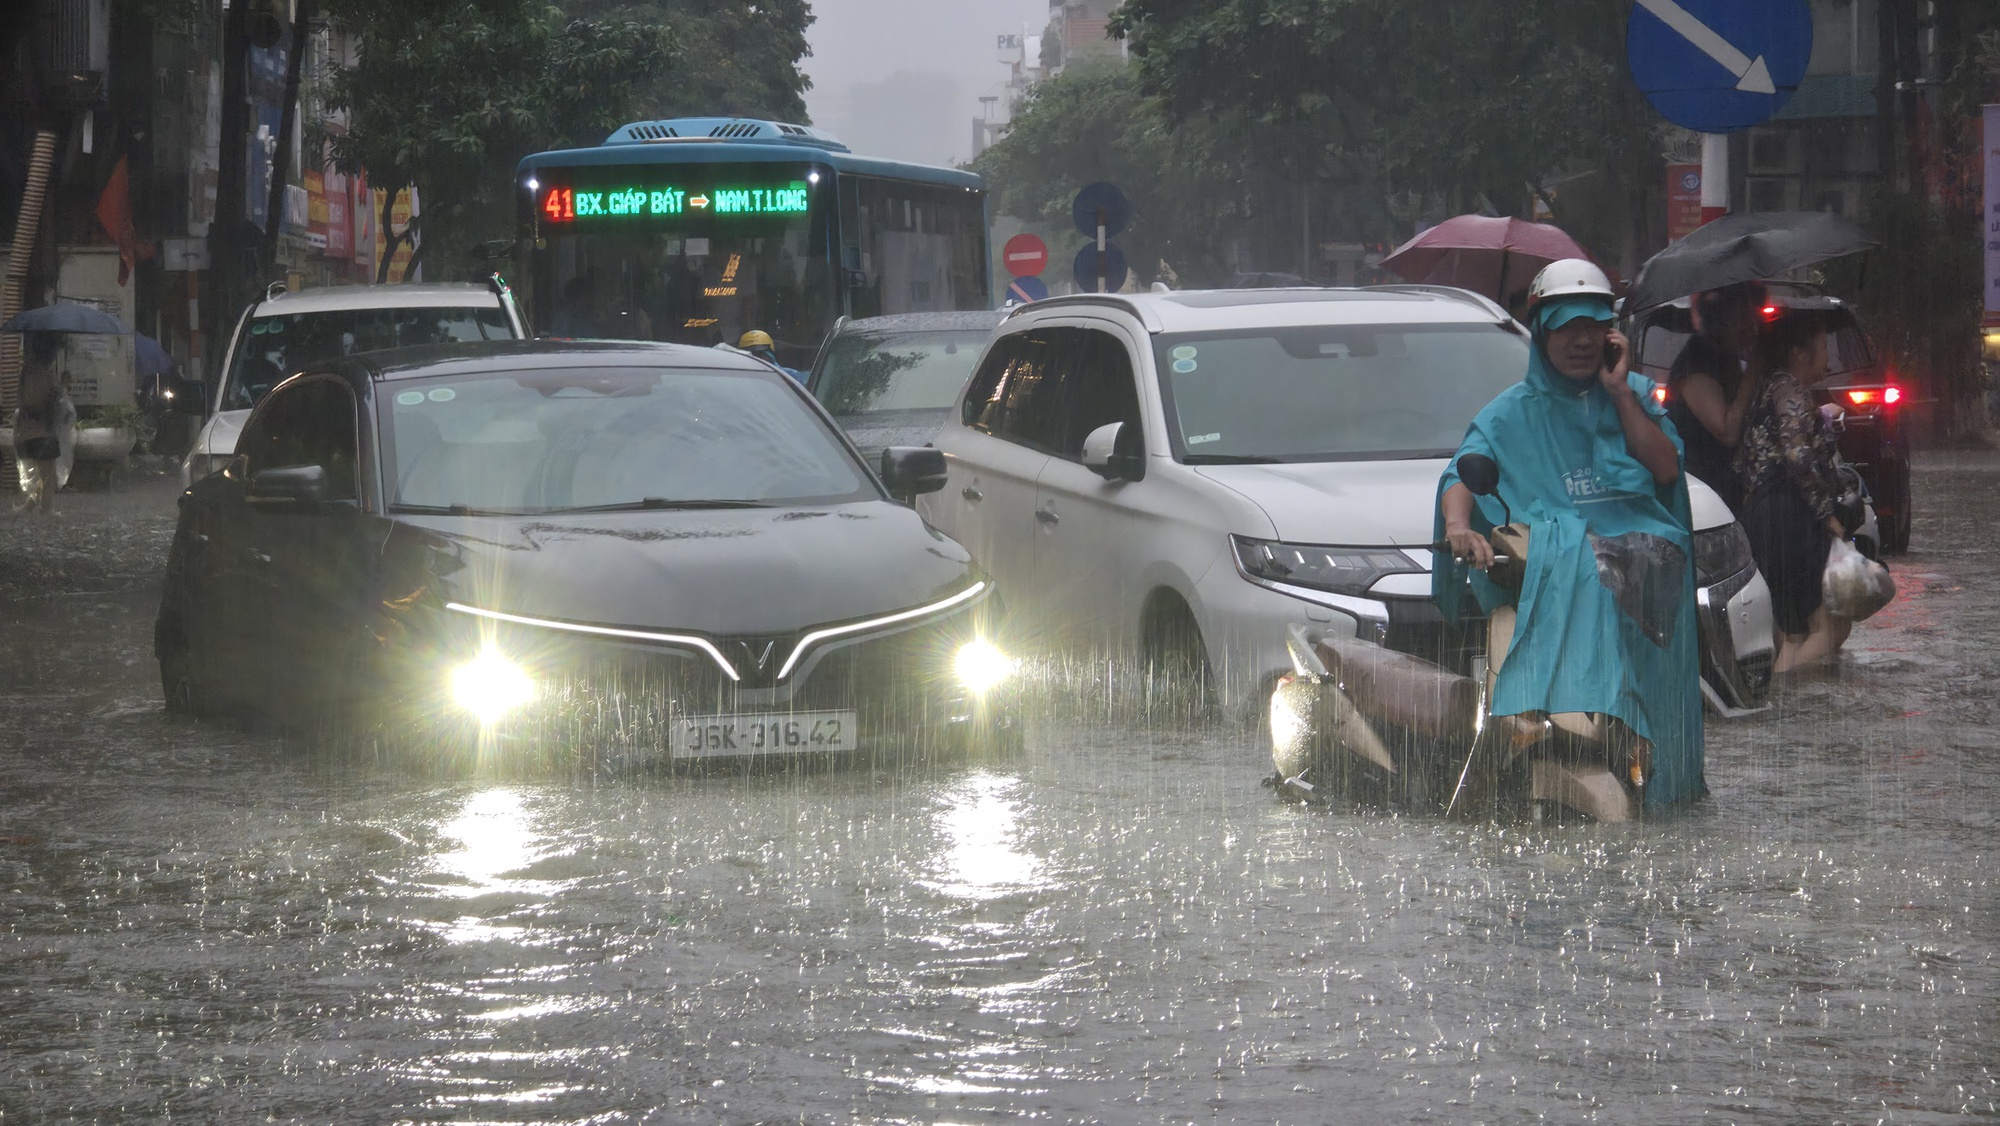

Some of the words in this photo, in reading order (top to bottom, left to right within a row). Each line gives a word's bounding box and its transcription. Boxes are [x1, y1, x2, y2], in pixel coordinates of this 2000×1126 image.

[546, 189, 573, 217] 41
[651, 186, 685, 213] BÁT
[715, 189, 807, 213] NAM.T.LONG
